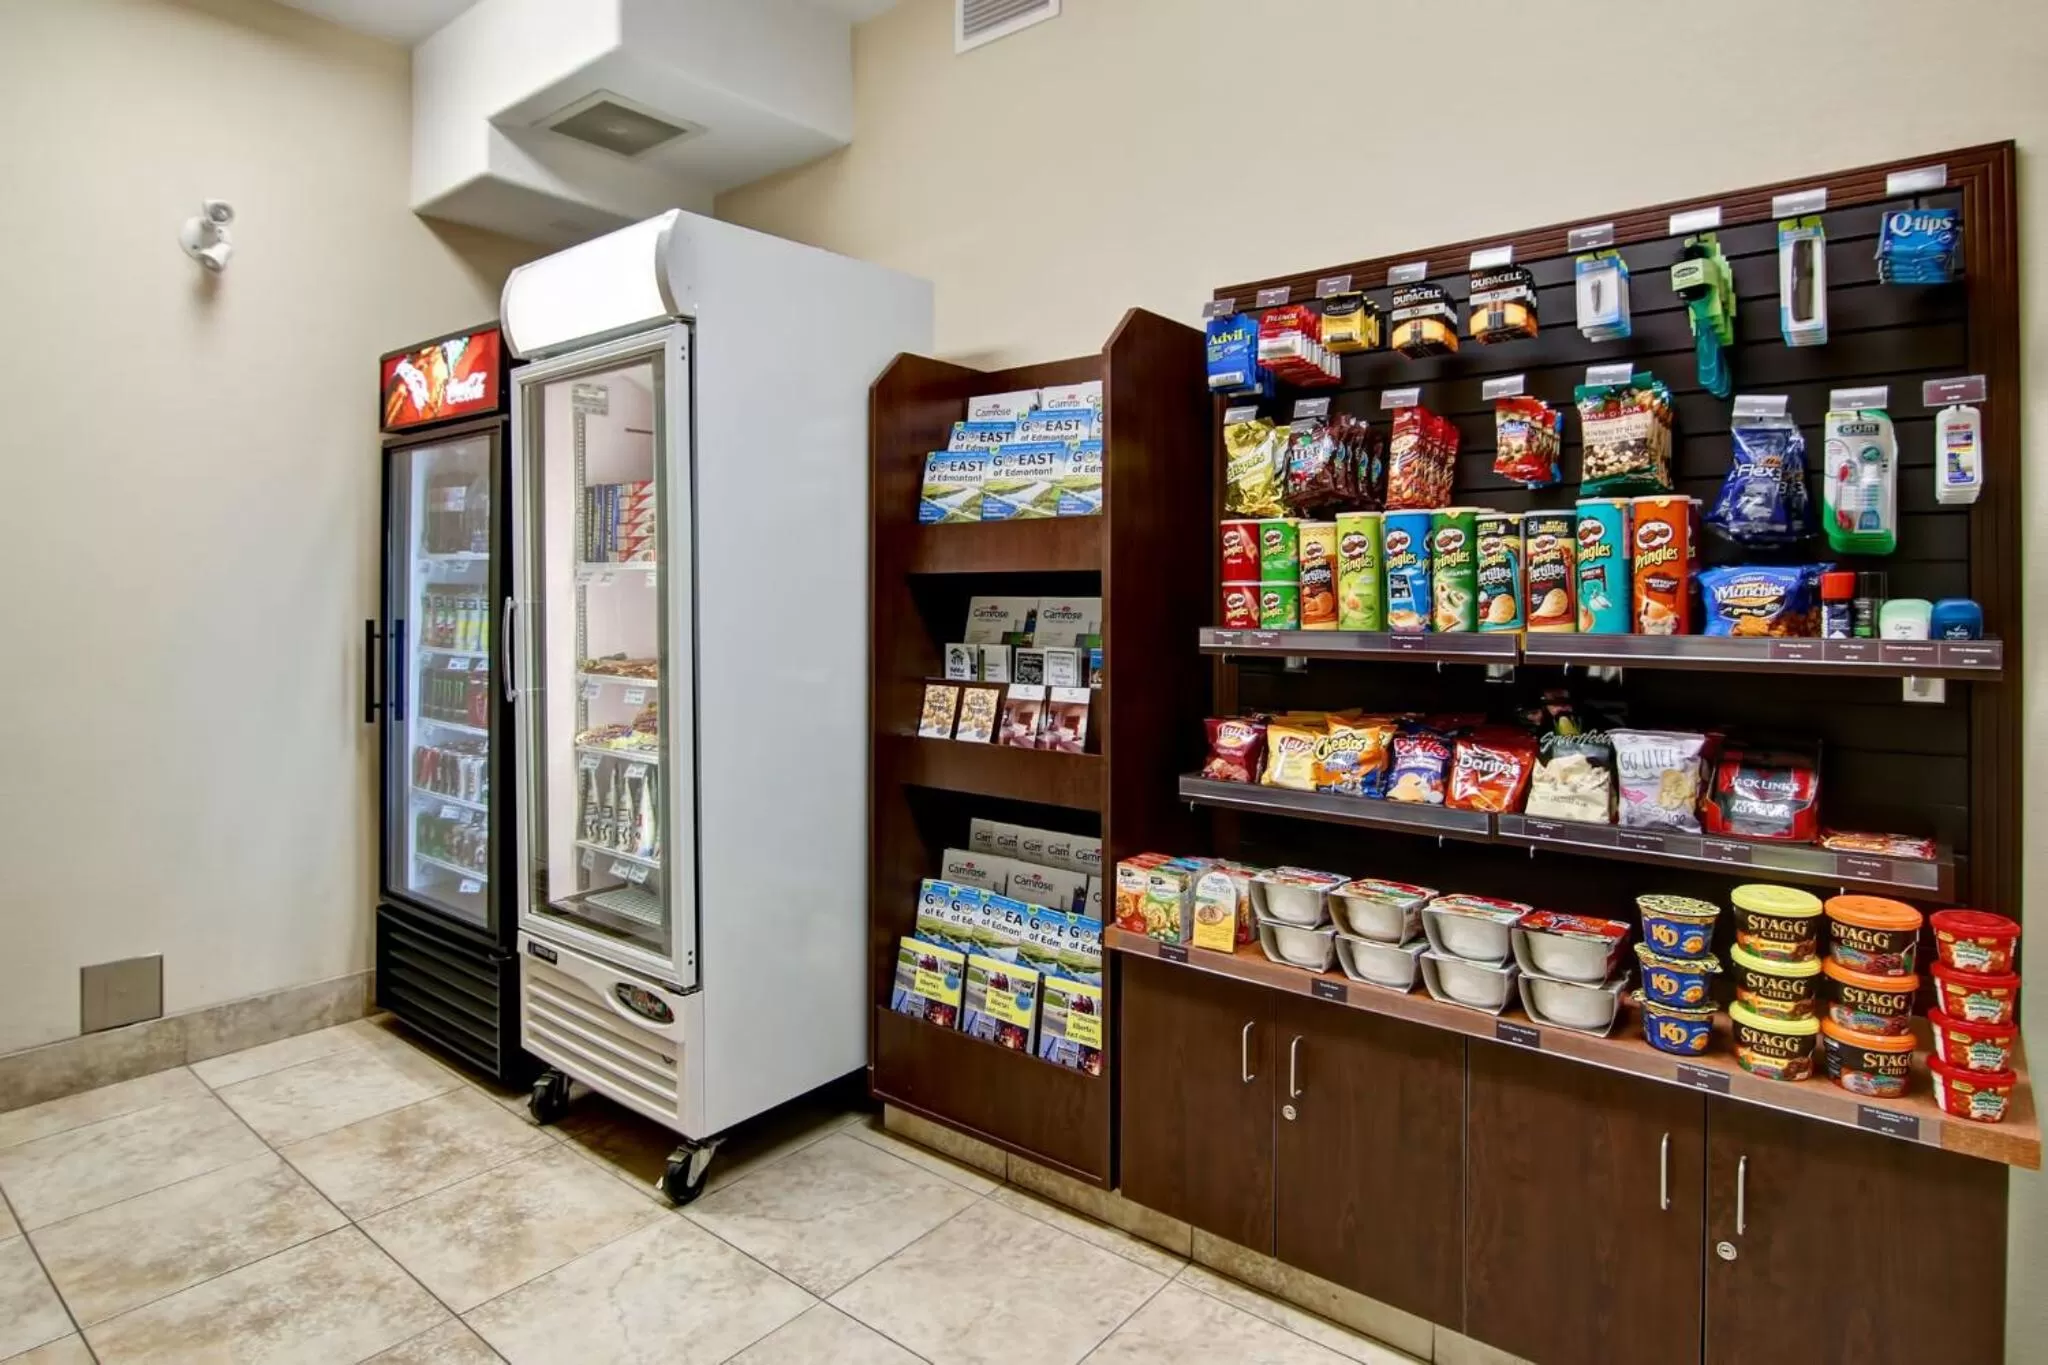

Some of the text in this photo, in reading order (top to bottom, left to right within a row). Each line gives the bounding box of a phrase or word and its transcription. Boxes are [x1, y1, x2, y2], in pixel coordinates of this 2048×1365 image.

[1889, 213, 1954, 236] Q-tips
[1471, 271, 1523, 289] DURACELL
[1393, 290, 1442, 305] DURACELL
[1208, 328, 1244, 346] Advil
[1046, 419, 1081, 432] EAST
[980, 431, 1012, 443] EAST
[950, 460, 984, 472] EAST
[1019, 452, 1056, 466] EAST
[993, 469, 1002, 477] of
[1072, 465, 1081, 474] of
[1738, 464, 1774, 478] Flex
[1635, 545, 1678, 573] Pringles
[1716, 582, 1785, 603] Munchies
[973, 609, 1009, 619] Camrose
[1043, 609, 1083, 621] Camrose
[1316, 732, 1366, 761] Cheetos
[1459, 753, 1520, 777] Doritos
[948, 864, 986, 878] Camrose
[1014, 874, 1053, 892] Camrose
[1747, 914, 1808, 936] STAGG
[1029, 931, 1039, 942] of
[1651, 923, 1679, 947] KD
[1760, 930, 1796, 941] CHILI
[1831, 920, 1891, 949] STAGG
[1069, 941, 1080, 951] of
[1841, 938, 1876, 952] CHILI
[1651, 973, 1679, 996] KD
[1746, 972, 1806, 995] STAGG
[1759, 988, 1793, 1000] CHILI
[1843, 987, 1906, 1011] STAGG
[1857, 1002, 1893, 1015] CHILI
[1659, 1021, 1688, 1045] KD
[1740, 1026, 1801, 1052] STAGG
[1752, 1043, 1788, 1057] CHILI
